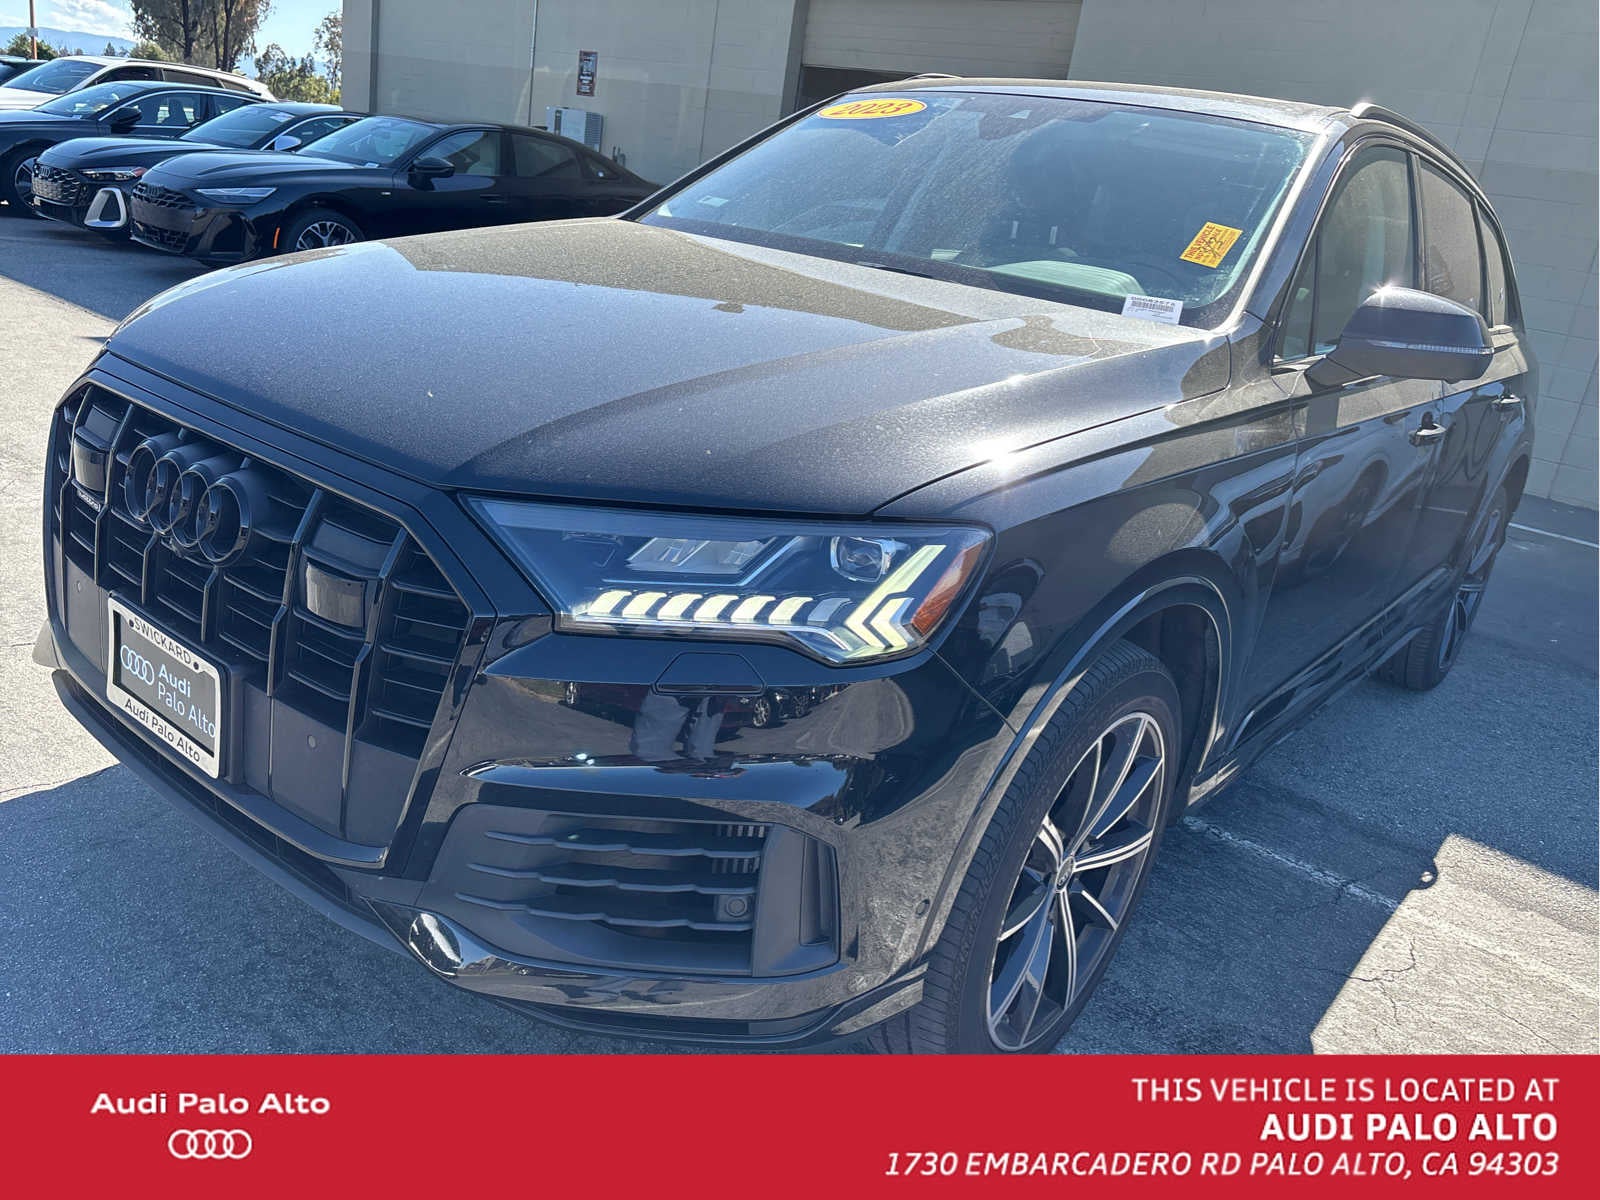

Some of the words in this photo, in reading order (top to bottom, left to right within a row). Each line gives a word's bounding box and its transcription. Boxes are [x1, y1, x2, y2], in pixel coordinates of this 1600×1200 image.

[831, 102, 913, 116] 2023
[134, 618, 191, 665] SWICKARD
[158, 664, 191, 698] Audi
[125, 698, 149, 723] Audi
[151, 718, 174, 742] Palo
[177, 737, 200, 762] Alto
[158, 684, 185, 716] Palo
[189, 705, 216, 738] Alto
